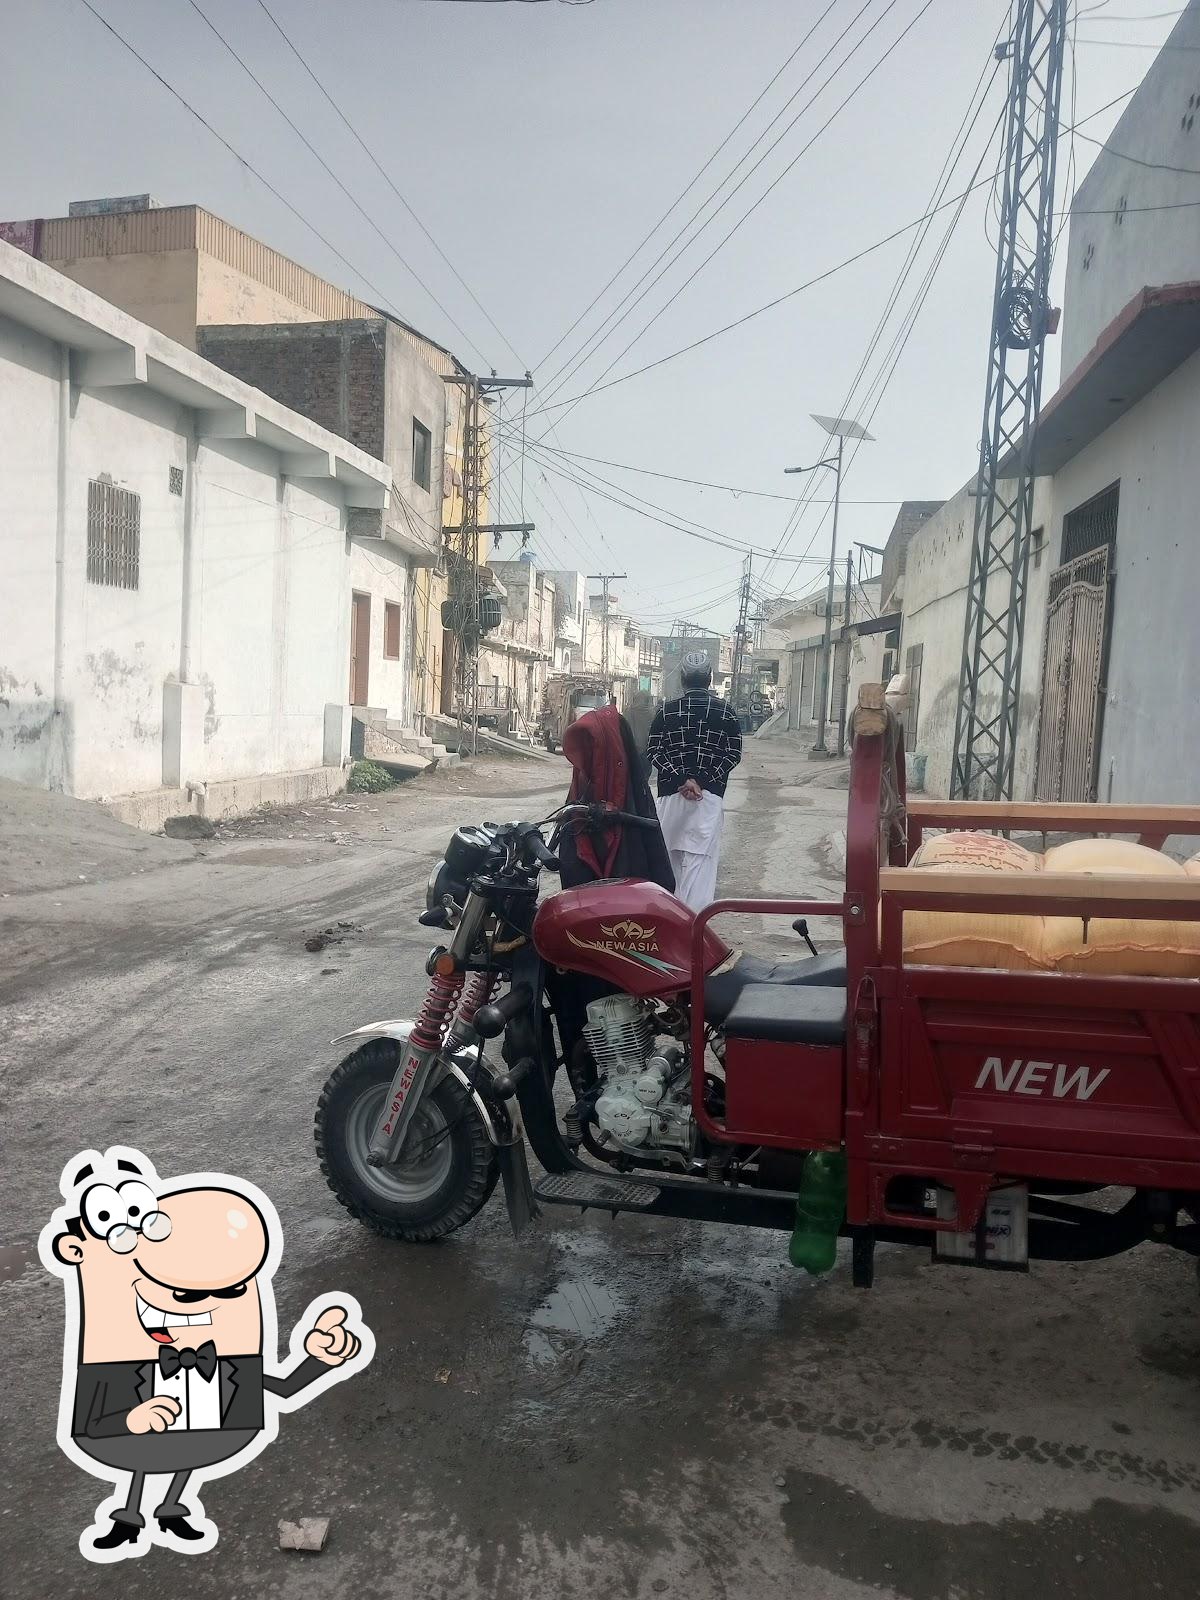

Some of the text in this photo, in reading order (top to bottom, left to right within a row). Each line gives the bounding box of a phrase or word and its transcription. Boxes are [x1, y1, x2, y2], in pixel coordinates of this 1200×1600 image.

[597, 941, 659, 952] NEW ASIA
[383, 1057, 418, 1135] NEW ASIA
[975, 1057, 1111, 1100] NEW
